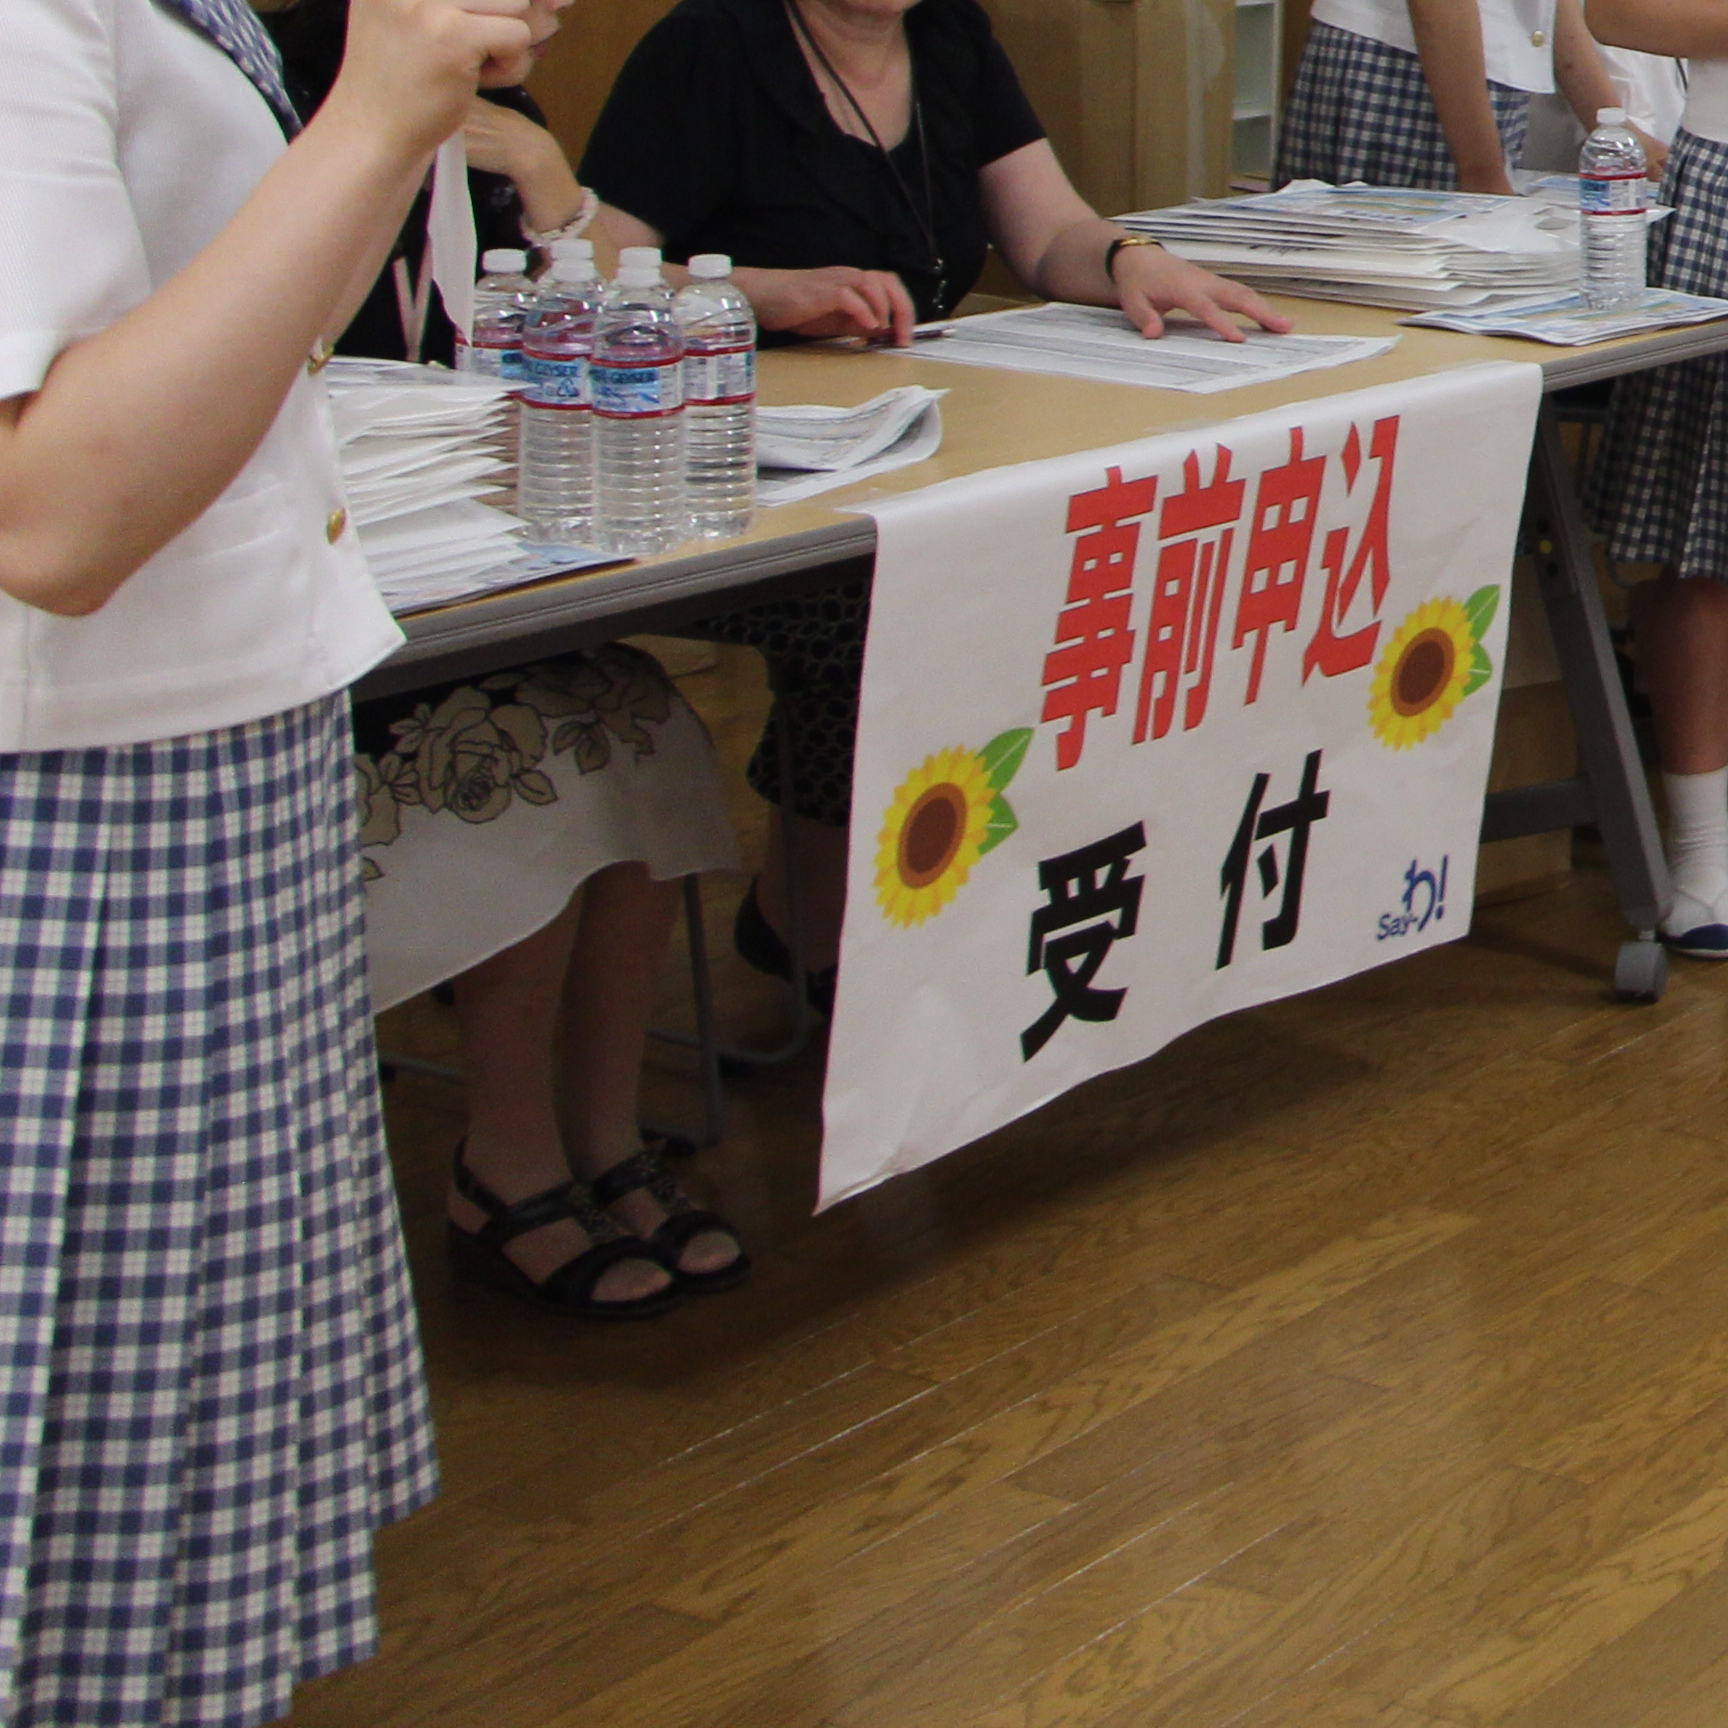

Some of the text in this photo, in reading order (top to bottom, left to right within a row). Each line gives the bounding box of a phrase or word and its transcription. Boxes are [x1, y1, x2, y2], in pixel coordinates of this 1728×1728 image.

[1040, 413, 1399, 771] 事前申込
[1020, 749, 1330, 1062] 受付
